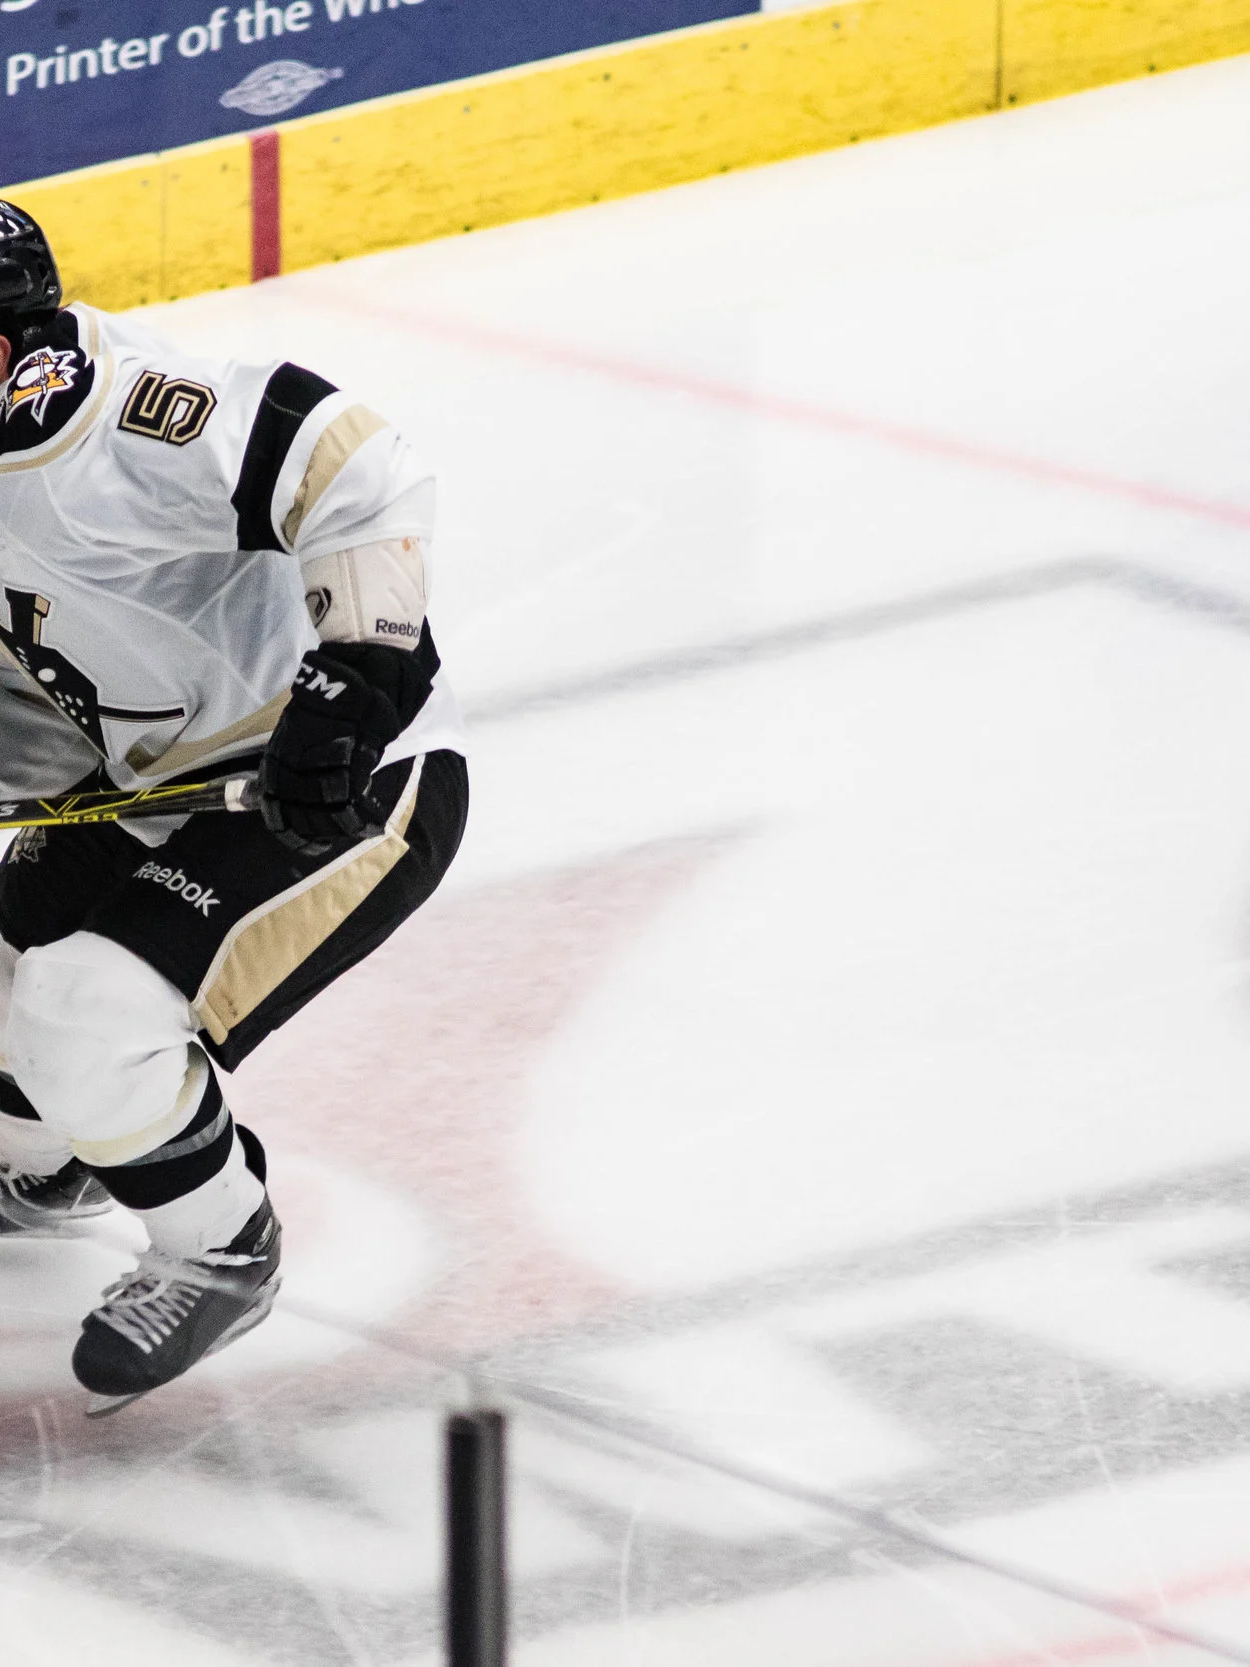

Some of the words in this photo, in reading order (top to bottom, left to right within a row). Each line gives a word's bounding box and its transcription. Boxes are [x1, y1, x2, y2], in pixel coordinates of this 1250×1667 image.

[6, 33, 170, 96] Printer
[177, 6, 229, 58] of
[235, 0, 313, 44] the
[116, 370, 218, 447] 5
[132, 860, 221, 919] Reebok
